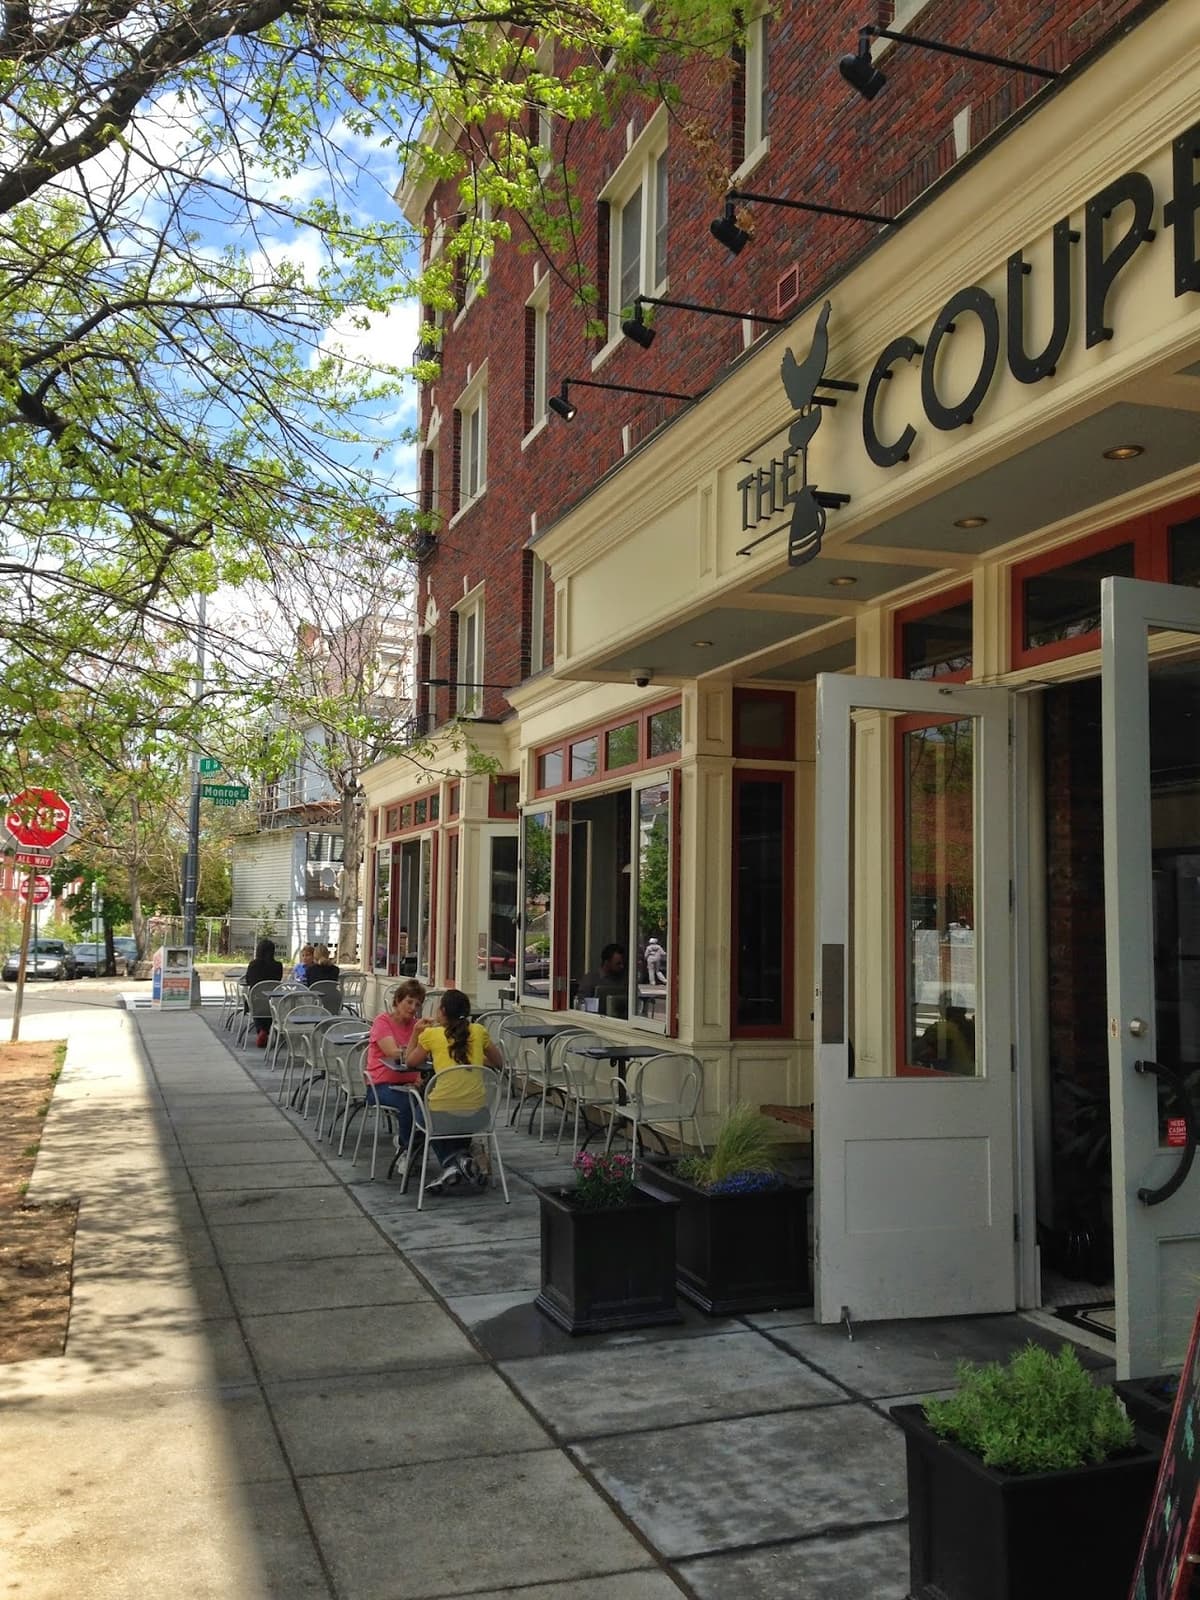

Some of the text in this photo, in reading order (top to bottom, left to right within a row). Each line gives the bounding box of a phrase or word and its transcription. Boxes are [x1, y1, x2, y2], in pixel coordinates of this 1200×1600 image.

[737, 446, 800, 531] THE
[204, 786, 240, 798] Monroe
[215, 797, 235, 806] 1000
[17, 854, 51, 866] ALL WAY
